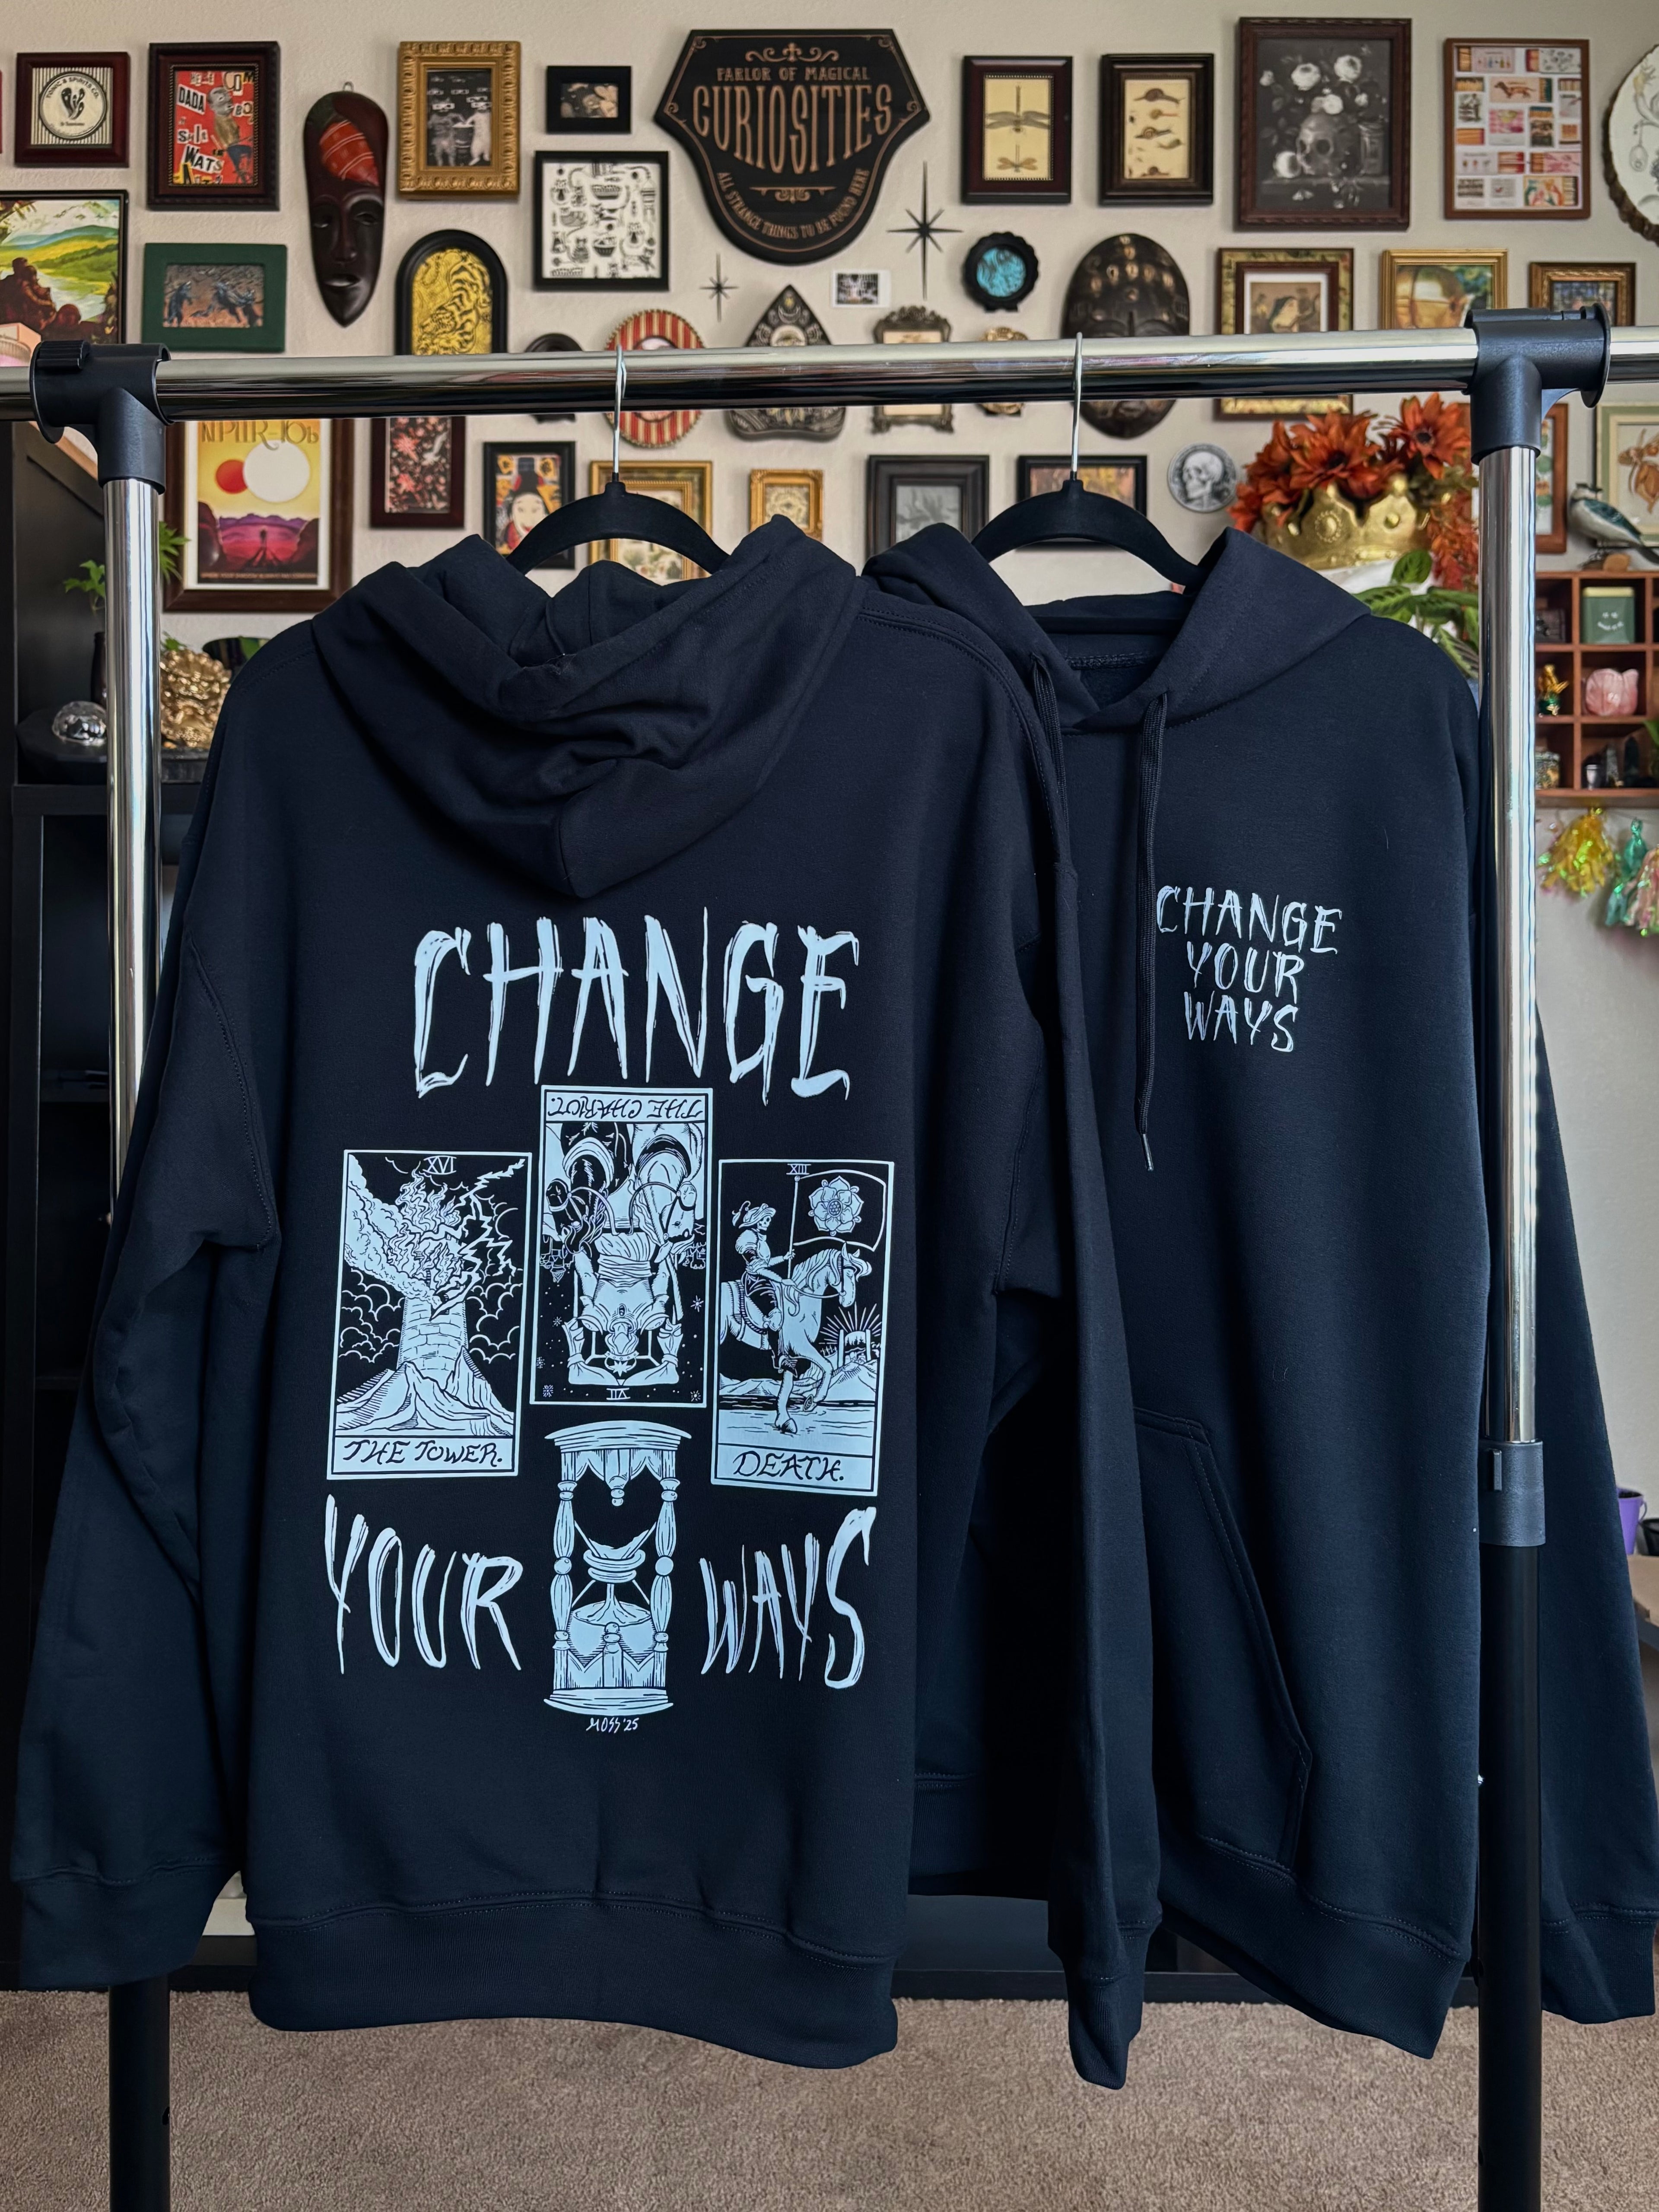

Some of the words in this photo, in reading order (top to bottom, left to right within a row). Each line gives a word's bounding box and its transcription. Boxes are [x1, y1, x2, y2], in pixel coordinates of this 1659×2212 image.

[717, 67, 771, 81] PARLOR
[779, 67, 798, 81] OF
[804, 67, 870, 81] MAGICAL
[179, 87, 204, 112] DADA
[693, 84, 893, 175] CURIOSITIES
[184, 146, 223, 172] WATS
[717, 172, 734, 192] ALL
[848, 168, 870, 197] HERE
[725, 191, 763, 230] STRANGE
[828, 196, 857, 227] FOUND
[762, 221, 798, 239] THINGS
[801, 224, 815, 238] TO
[815, 218, 832, 234] BE
[1157, 885, 1342, 954] CHANGE
[1186, 941, 1304, 1004] YOUR
[413, 906, 859, 1106] CHANGE
[1184, 991, 1298, 1052] WAYS
[547, 1096, 642, 1119] CHARIOT.
[647, 1098, 703, 1119] THE
[423, 1155, 457, 1175] XVI
[786, 1163, 811, 1175] XIII
[607, 1387, 630, 1400] VII
[343, 1440, 410, 1465] THE
[414, 1440, 502, 1467] TOWER.
[733, 1450, 844, 1481] DEATH.
[325, 1494, 523, 1674] YOUR
[700, 1507, 876, 1688] WAYS
